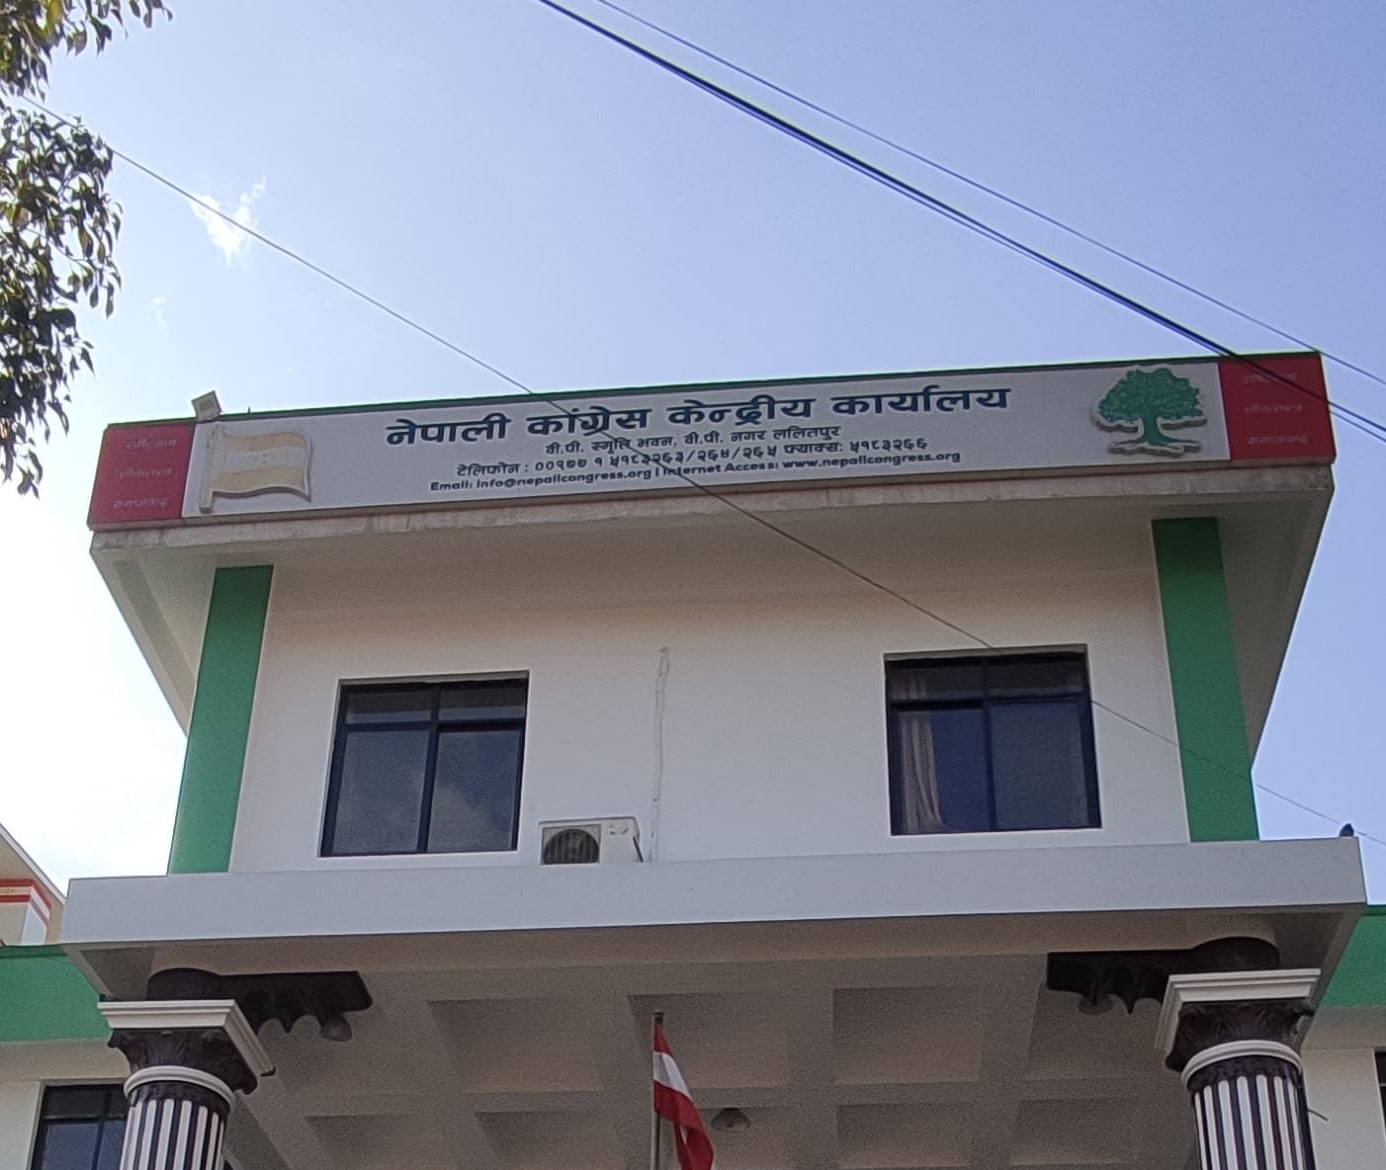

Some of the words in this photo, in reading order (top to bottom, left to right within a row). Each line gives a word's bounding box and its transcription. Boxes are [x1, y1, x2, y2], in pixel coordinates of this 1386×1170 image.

[386, 412, 511, 446] नेपाली
[526, 405, 653, 437] कांग्रेस
[667, 395, 817, 427] केन्द्रीय
[830, 385, 1012, 416] कार्यालय
[730, 429, 767, 442] नगर
[773, 425, 842, 441] ललितपुर
[430, 478, 473, 491] Email:
[476, 467, 652, 488] info@nepalicongress.org
[663, 462, 721, 476] Internet
[724, 462, 779, 473] Access:
[782, 452, 961, 469] www.nepalicongress.org
[456, 461, 521, 477] टेलिफोन
